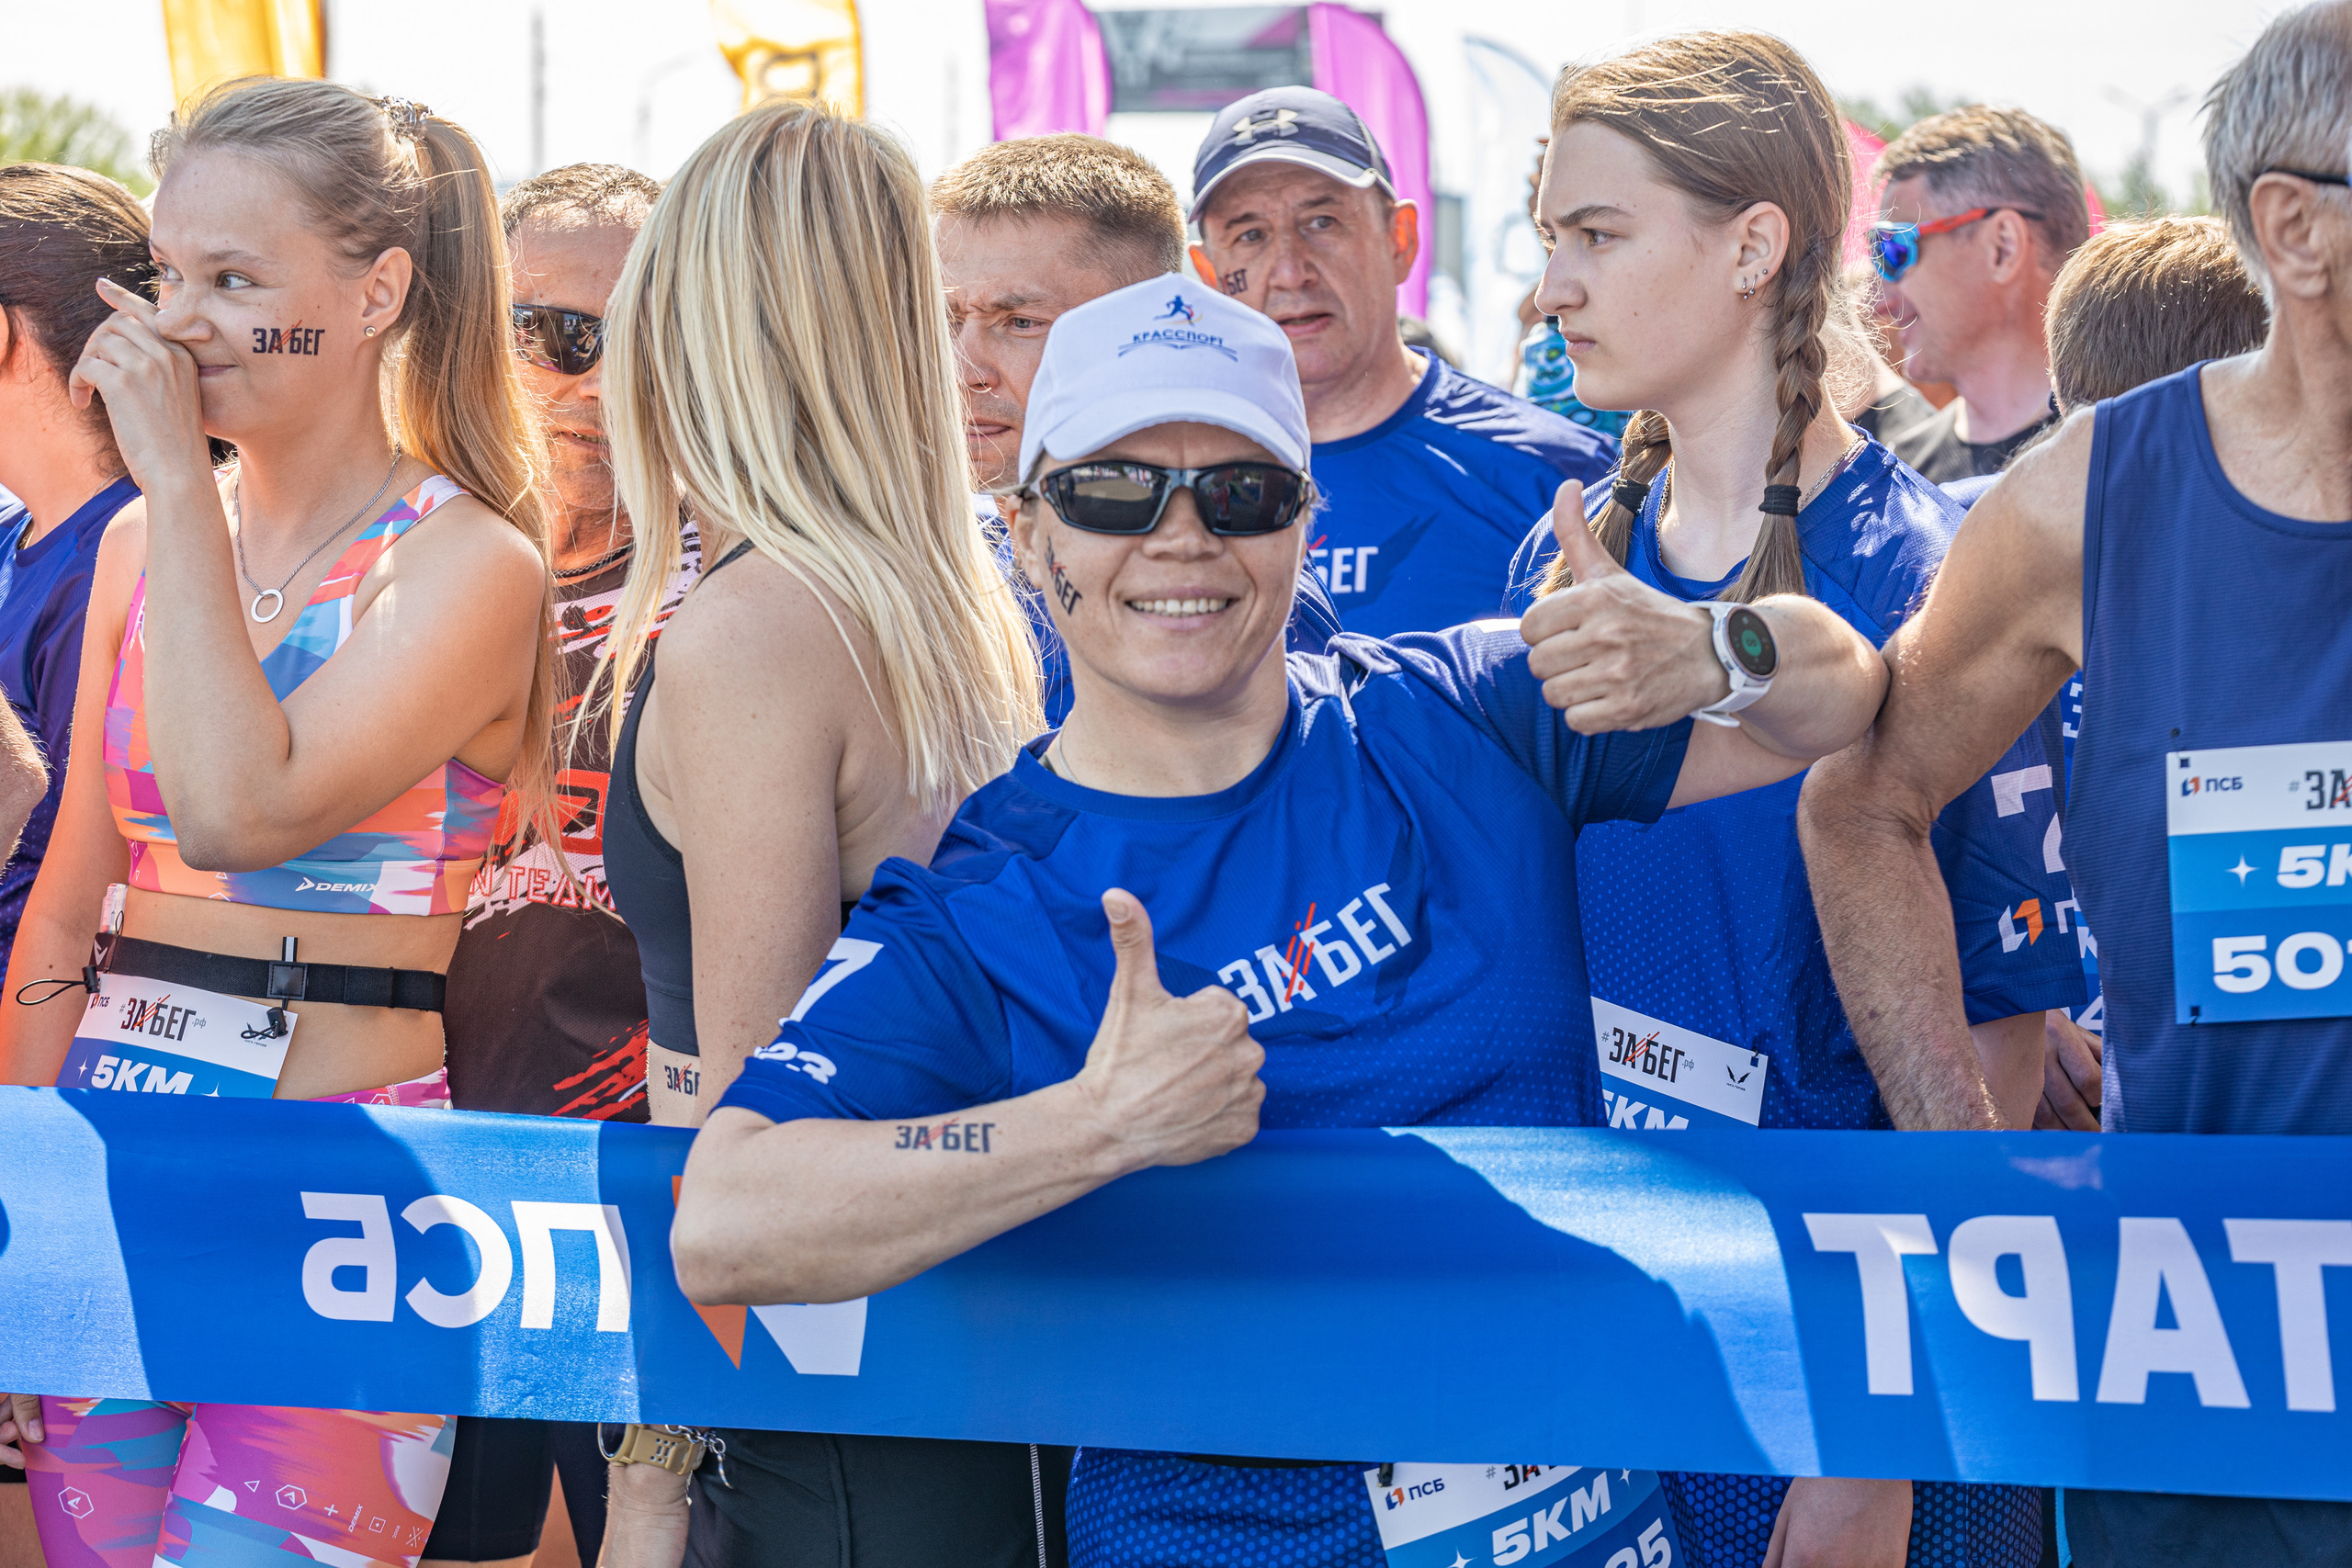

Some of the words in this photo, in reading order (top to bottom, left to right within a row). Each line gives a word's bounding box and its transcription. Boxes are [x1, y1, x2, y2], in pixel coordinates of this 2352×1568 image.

[252, 326, 325, 356] ЗАБЕГ
[1133, 329, 1224, 345] КРАССПОРТ
[2205, 776, 2244, 794] ПСБ
[315, 882, 381, 892] DEMIX
[2211, 931, 2352, 994] 50
[895, 1122, 996, 1154] ЗАБЕГ
[1408, 1477, 1445, 1502] ПСБ
[347, 1503, 363, 1533] DEMIX
